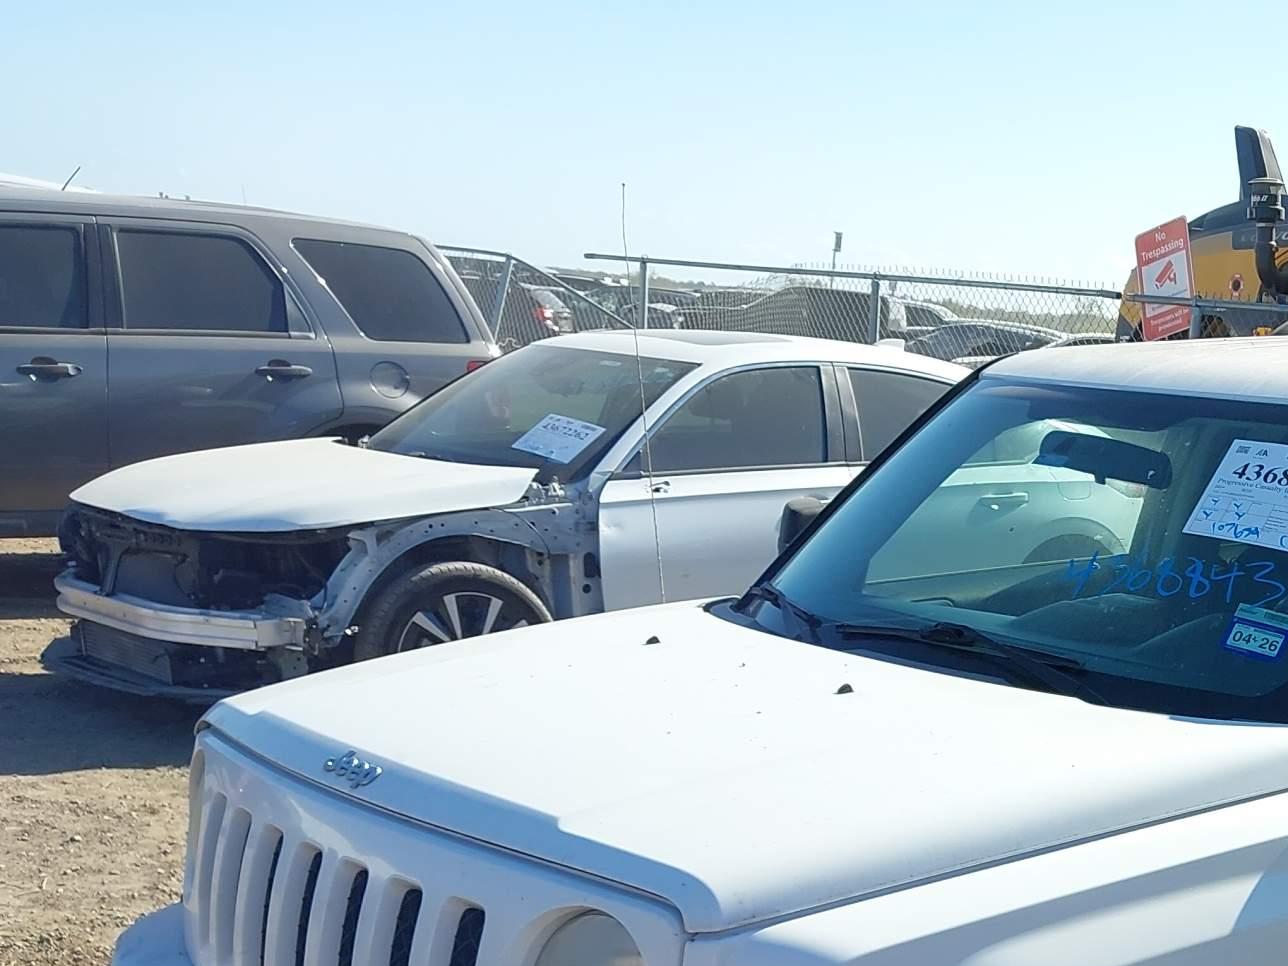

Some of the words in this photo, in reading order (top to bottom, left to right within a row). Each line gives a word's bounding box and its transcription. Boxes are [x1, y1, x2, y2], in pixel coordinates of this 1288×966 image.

[1155, 231, 1166, 242] No
[1142, 238, 1184, 261] Trespassing
[1232, 630, 1252, 645] 04
[1257, 637, 1280, 652] 26
[323, 750, 383, 789] Jeep
